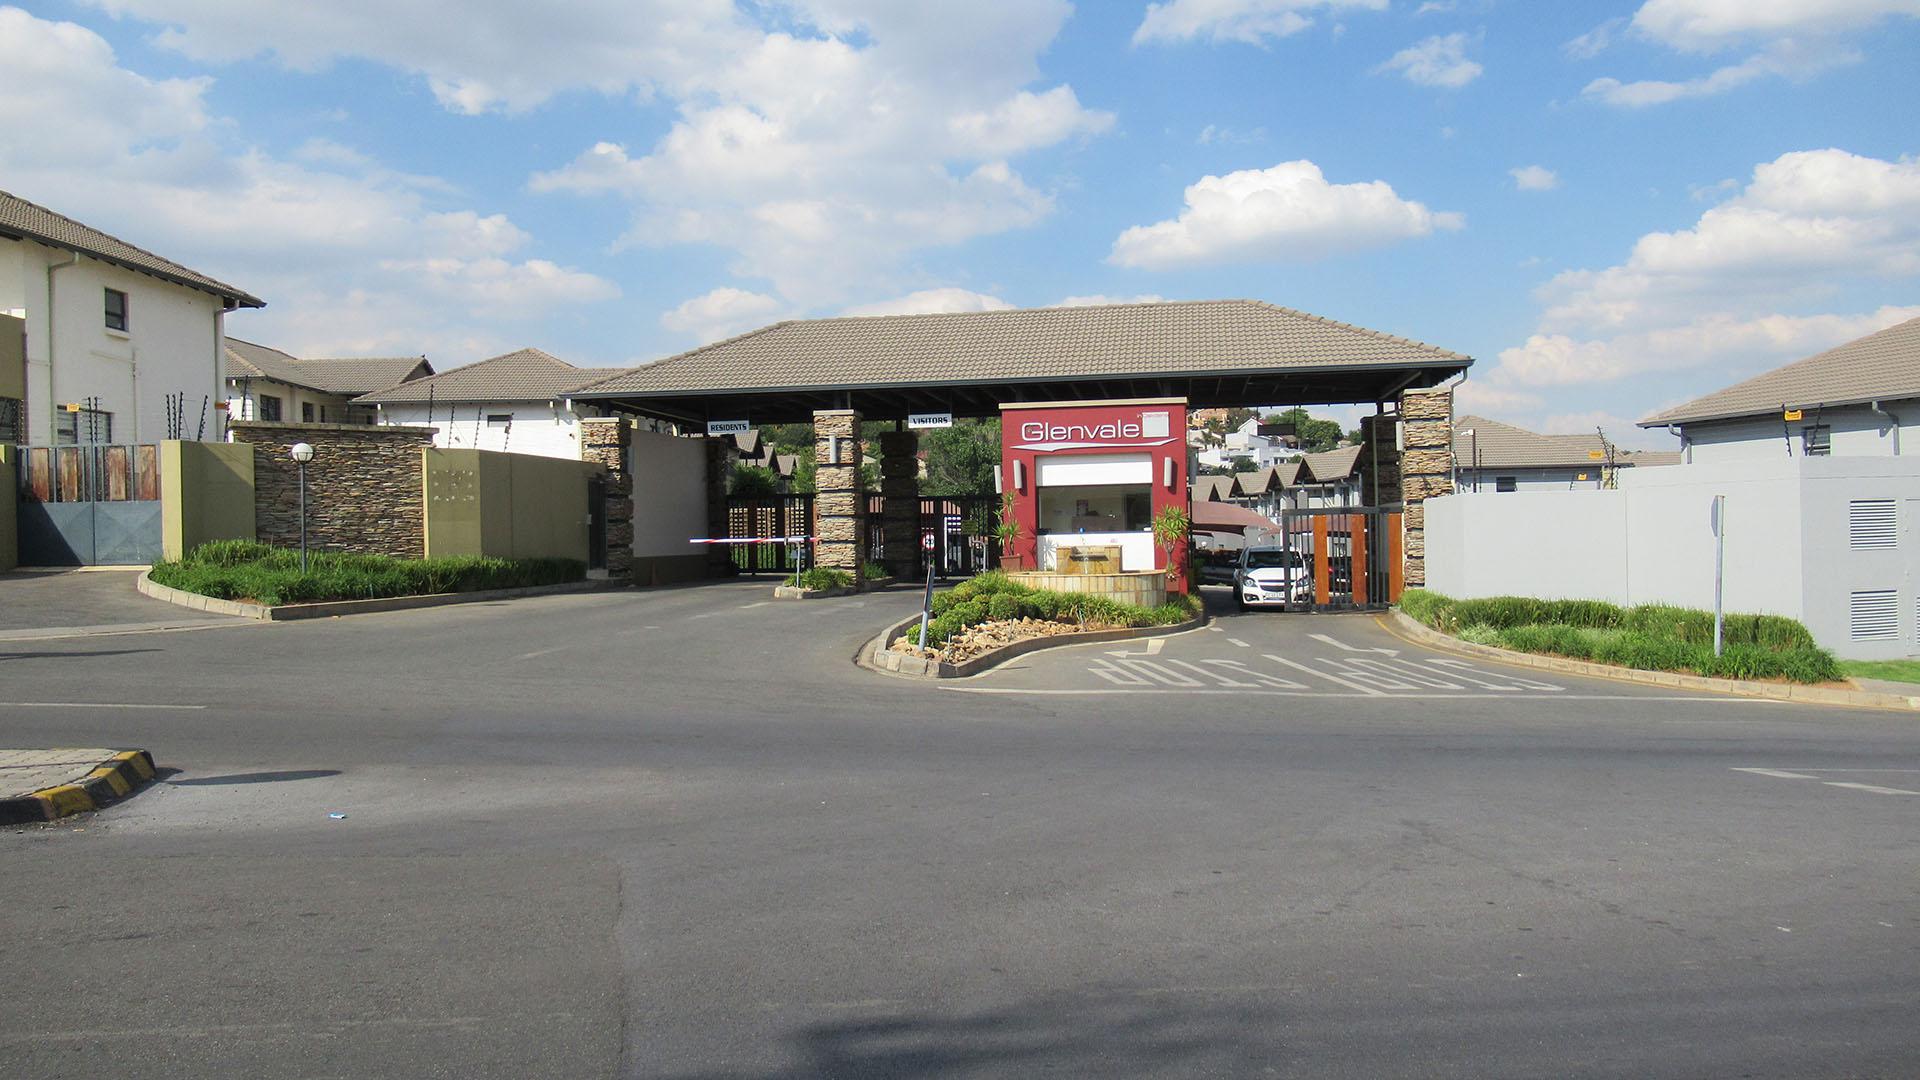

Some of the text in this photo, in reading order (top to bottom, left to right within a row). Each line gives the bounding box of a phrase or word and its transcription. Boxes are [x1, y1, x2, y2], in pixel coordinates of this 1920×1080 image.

[710, 423, 747, 431] RESIDENTS
[912, 416, 948, 424] VISITORS
[1021, 419, 1140, 441] Glenvale
[1088, 659, 1311, 689] STOP
[1313, 657, 1566, 691] STOP
